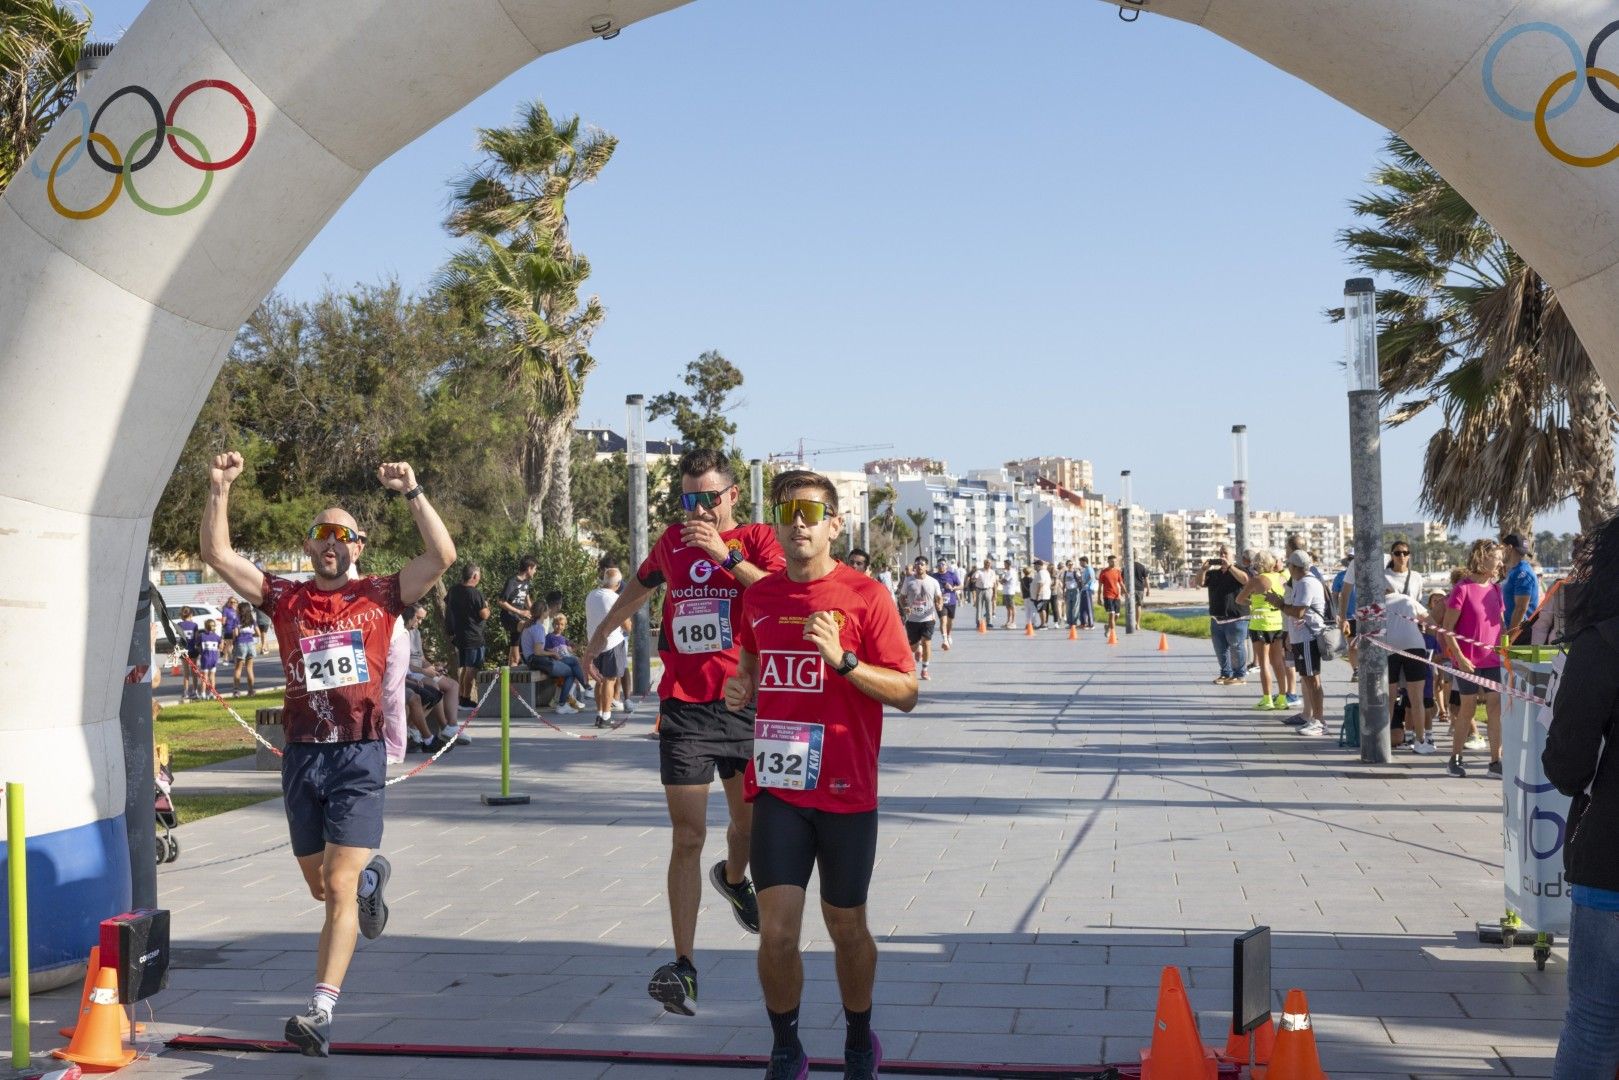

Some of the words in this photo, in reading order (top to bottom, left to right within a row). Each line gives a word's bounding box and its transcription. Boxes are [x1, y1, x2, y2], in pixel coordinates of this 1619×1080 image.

[671, 585, 738, 597] vodafone
[678, 624, 716, 643] 180
[721, 618, 729, 633] KM
[309, 657, 353, 680] 218
[760, 655, 818, 688] AIG
[756, 752, 802, 775] 132
[809, 748, 820, 770] KM
[807, 772, 817, 780] 7
